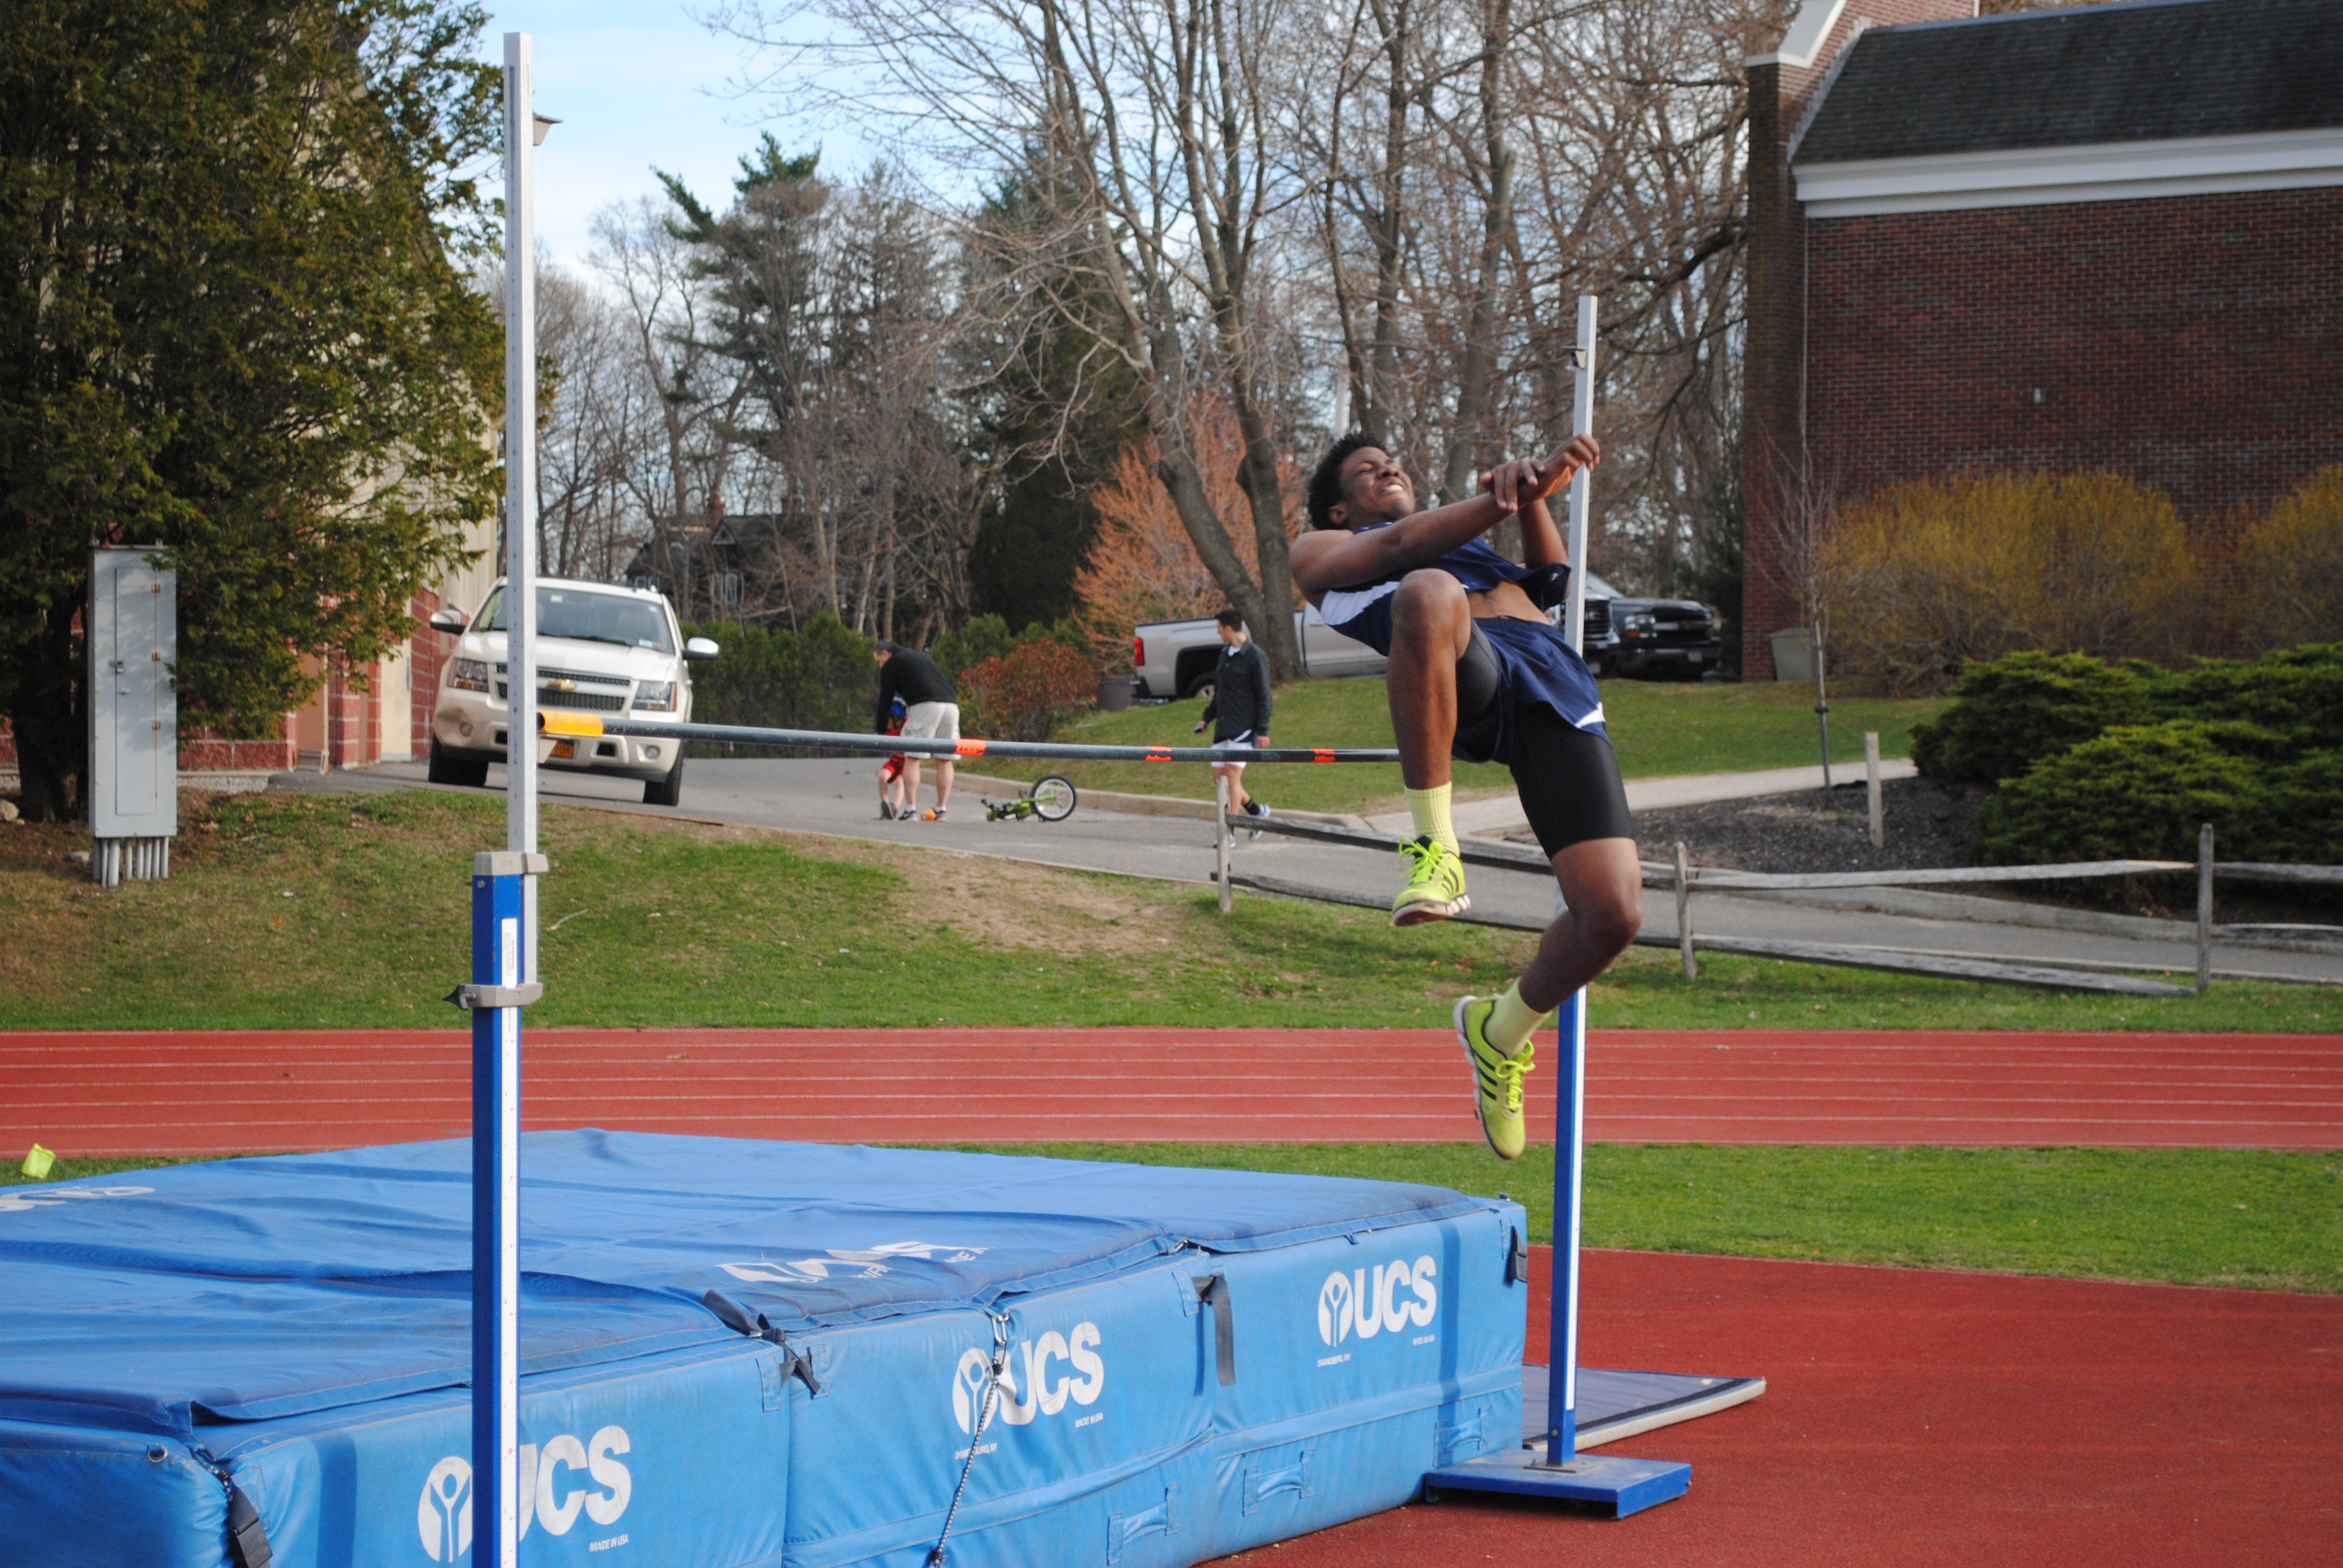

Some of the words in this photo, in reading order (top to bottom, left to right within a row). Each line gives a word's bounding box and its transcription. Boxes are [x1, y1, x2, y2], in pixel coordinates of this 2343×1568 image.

[1354, 1255, 1437, 1339] UCS
[995, 1321, 1104, 1425] UCS
[589, 1539, 611, 1552] MADE
[611, 1537, 617, 1548] IN
[617, 1534, 629, 1546] USA
